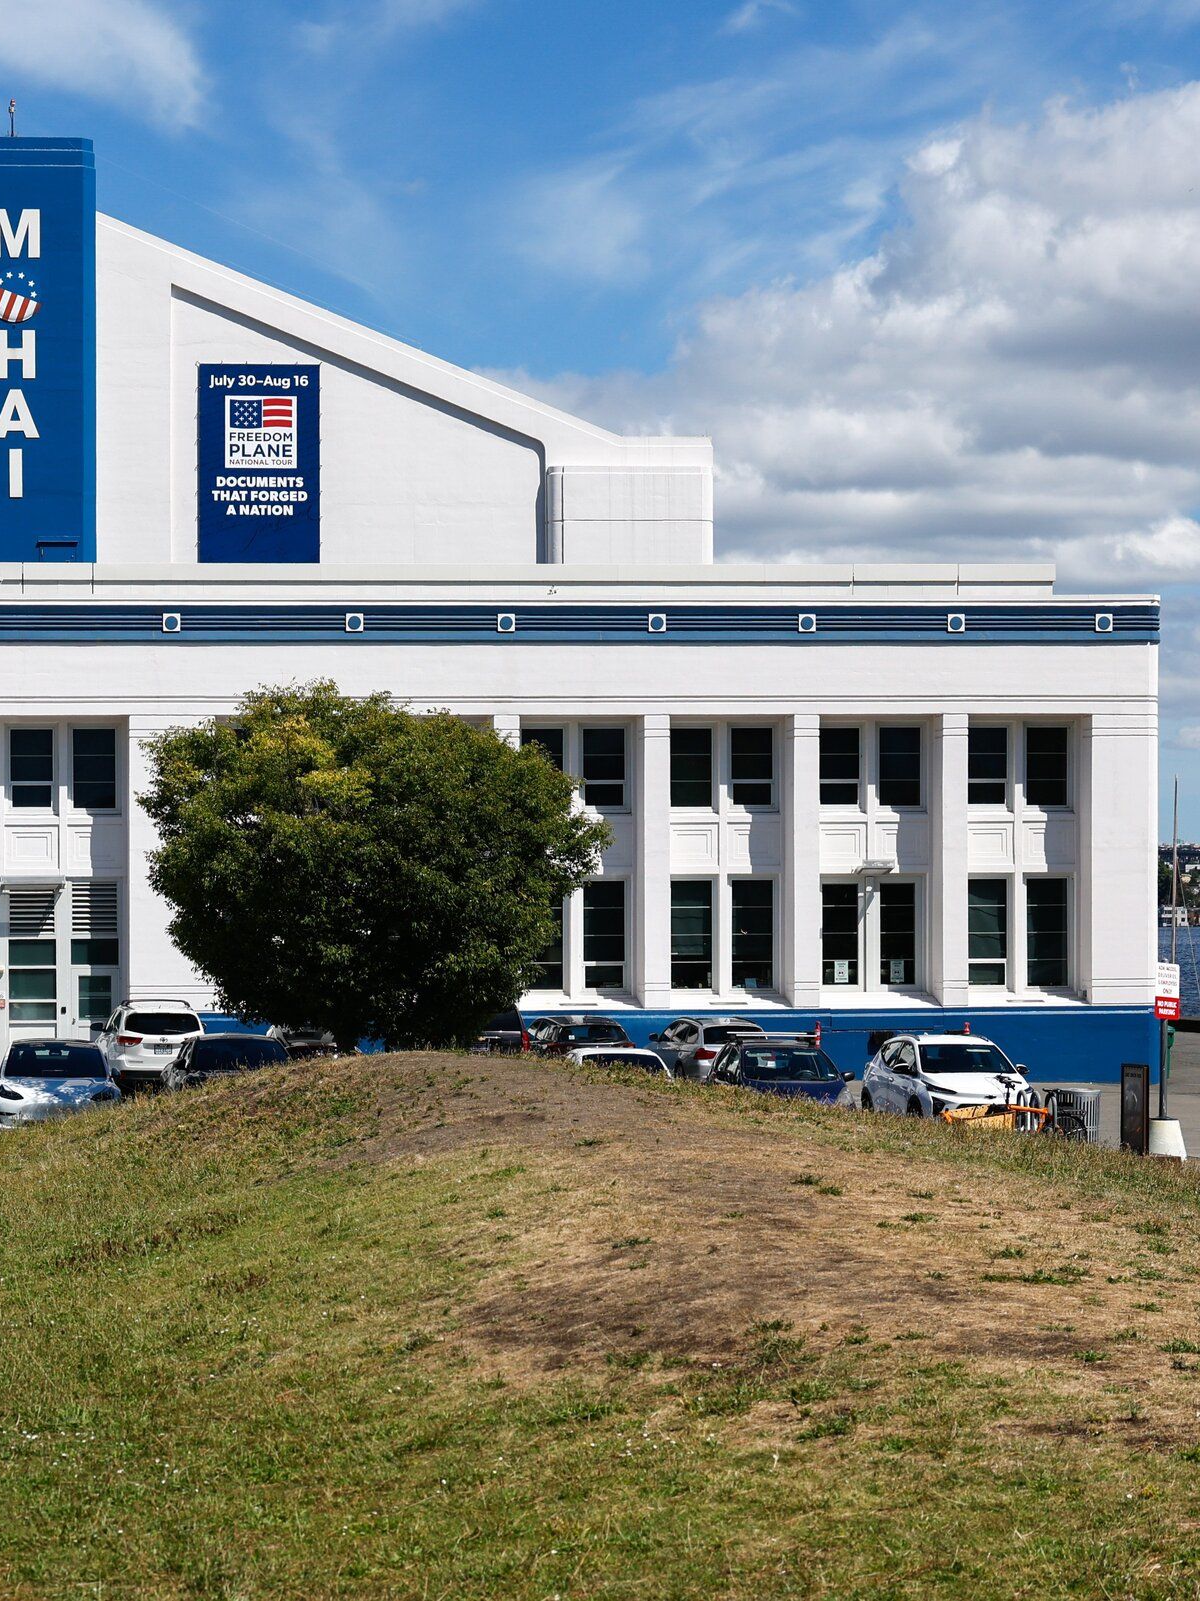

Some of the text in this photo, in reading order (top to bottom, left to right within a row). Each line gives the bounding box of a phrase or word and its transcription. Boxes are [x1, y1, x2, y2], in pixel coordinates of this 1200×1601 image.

[209, 375, 235, 388] July
[293, 375, 309, 386] 16
[229, 432, 293, 442] FREEDOM
[229, 444, 293, 458] PLANE
[216, 476, 304, 488] DOCUMENTS
[212, 490, 308, 502] THAT FORGED
[226, 504, 294, 516] A NATION
[1158, 1008, 1175, 1016] PARKING
